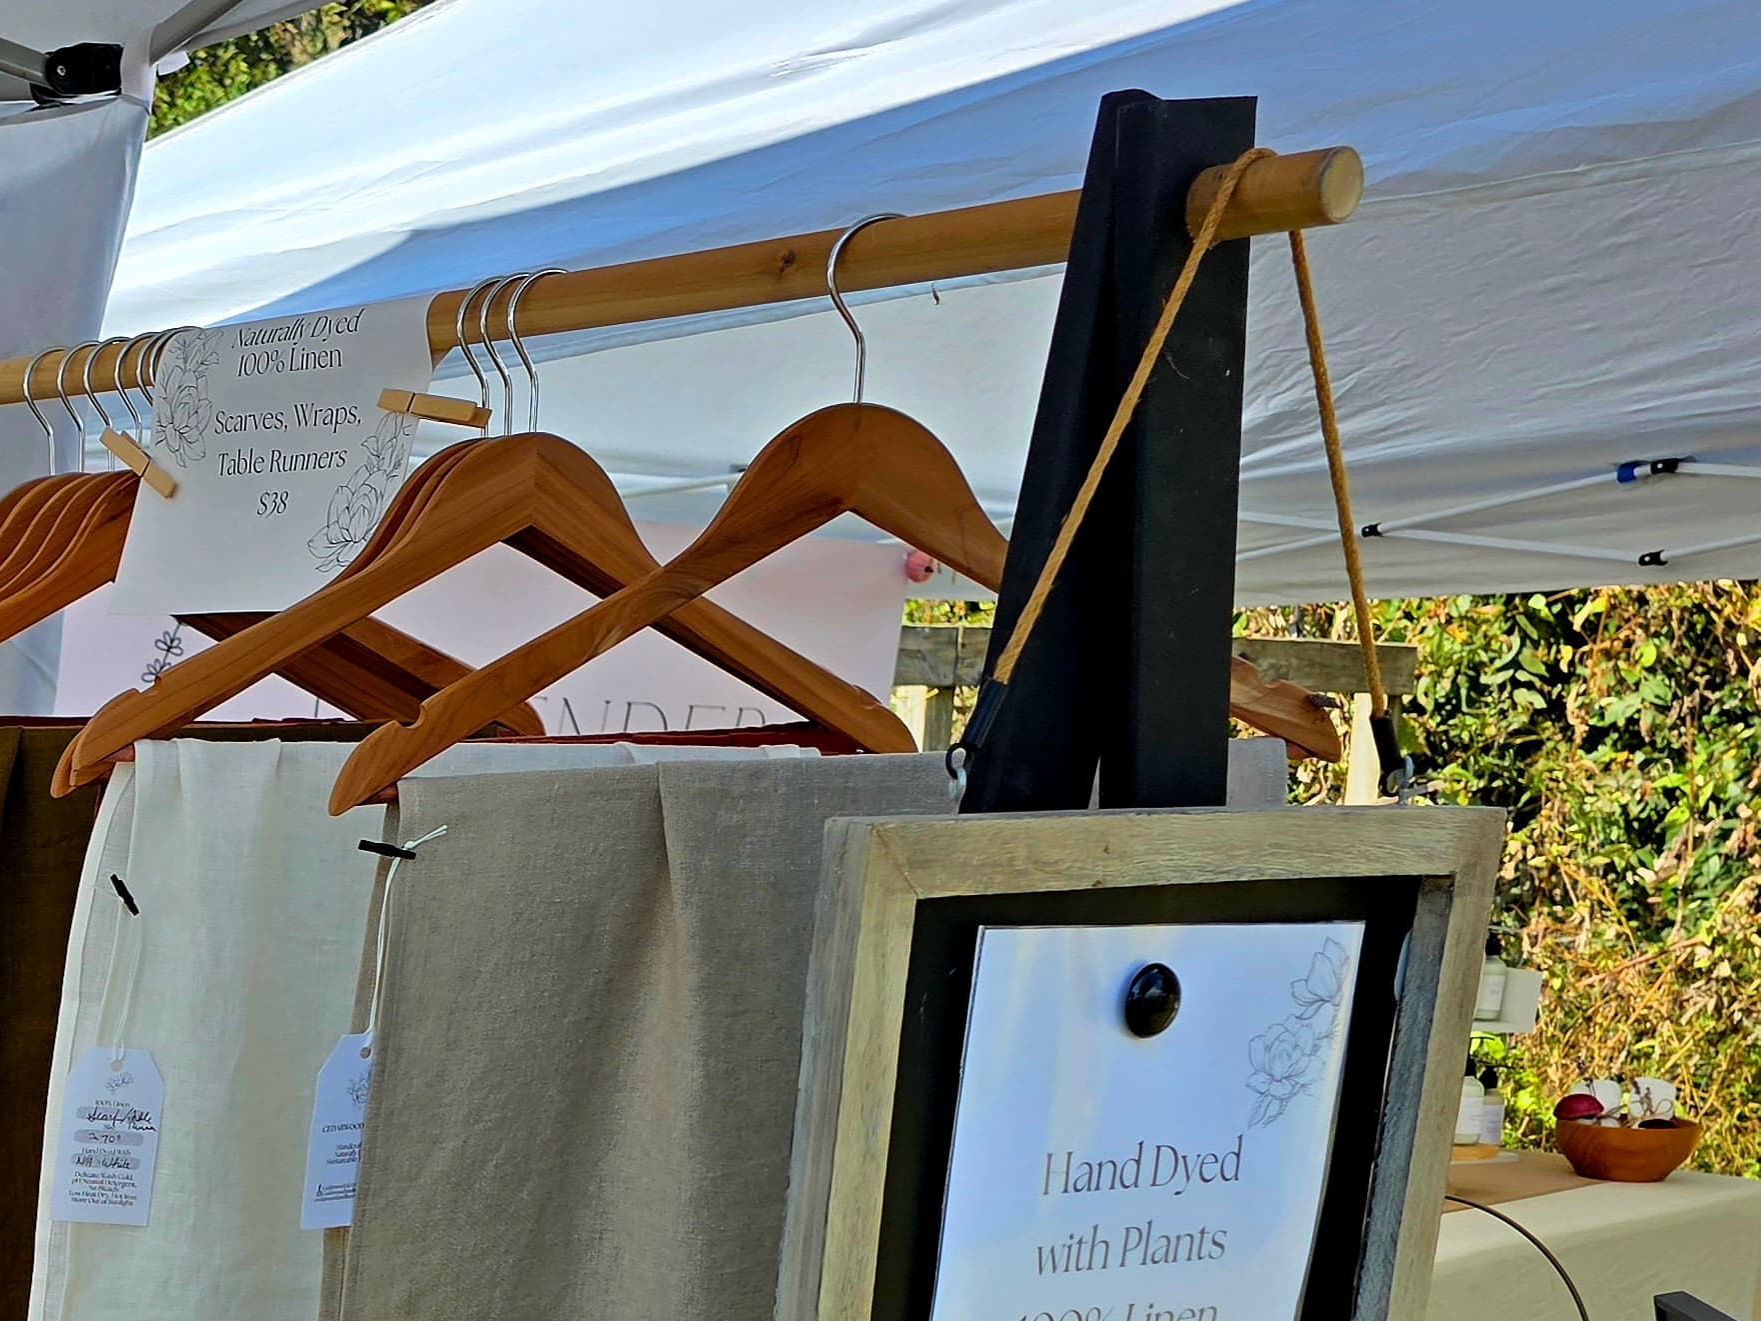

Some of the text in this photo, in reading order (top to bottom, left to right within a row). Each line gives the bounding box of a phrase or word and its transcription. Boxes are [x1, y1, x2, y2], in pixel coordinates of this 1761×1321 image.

[232, 309, 365, 349] Naturally Dyed
[238, 346, 342, 377] 100% Linen
[214, 403, 361, 435] Scarves, Wraps,
[218, 448, 347, 476] Table Runners
[256, 491, 289, 518] $38
[1043, 1134, 1243, 1196] Hand Dyed
[1036, 1220, 1228, 1276] with Plants
